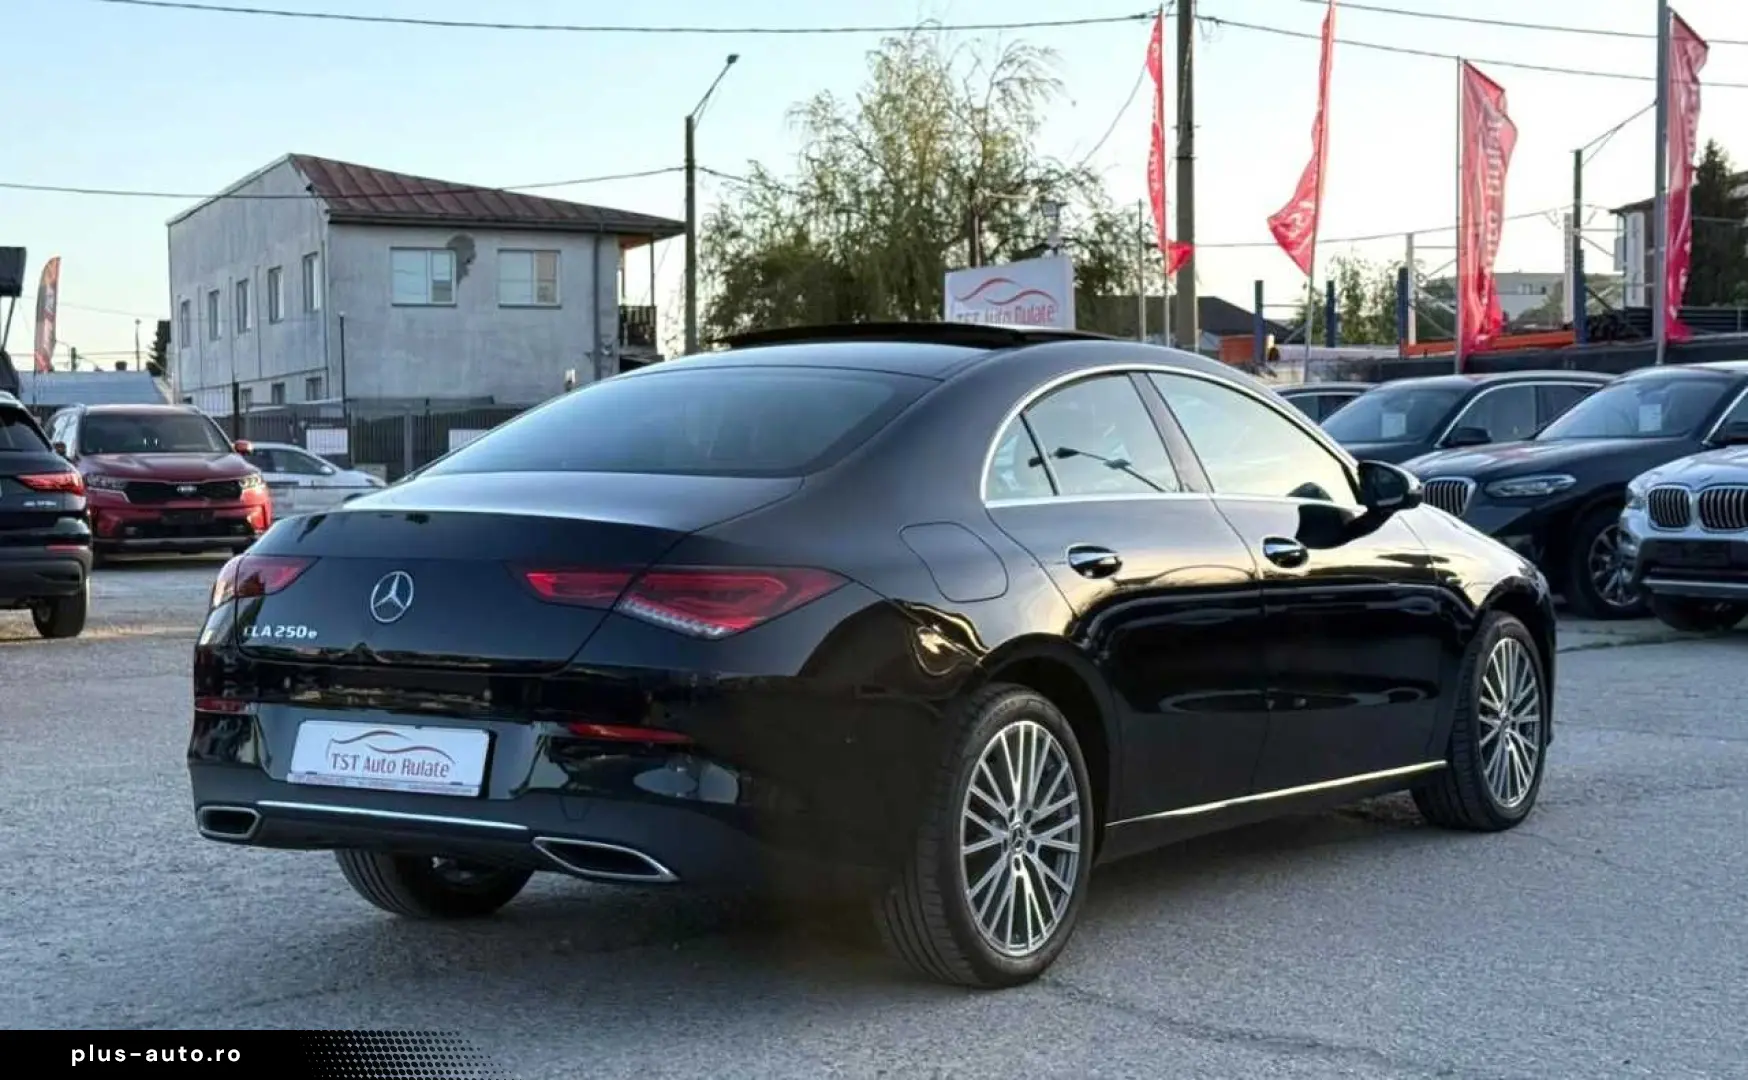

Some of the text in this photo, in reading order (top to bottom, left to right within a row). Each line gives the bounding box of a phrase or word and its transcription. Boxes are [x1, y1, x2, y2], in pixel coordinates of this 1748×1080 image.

[331, 753, 450, 778] TST Auto Rulate
